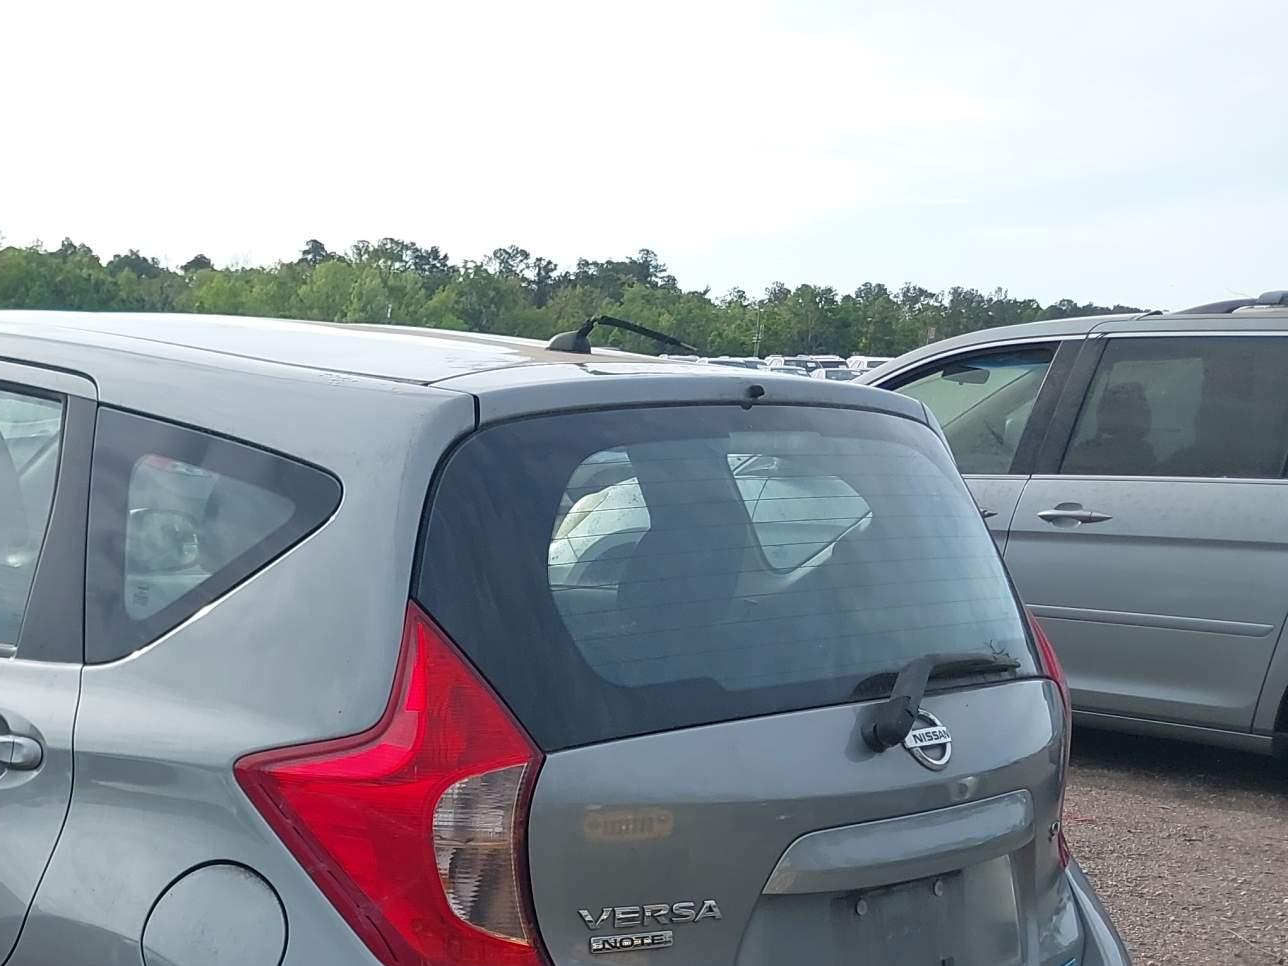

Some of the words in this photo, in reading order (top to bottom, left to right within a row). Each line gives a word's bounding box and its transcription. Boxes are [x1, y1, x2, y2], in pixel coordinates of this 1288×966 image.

[912, 729, 951, 744] NISSAN
[577, 899, 722, 930] VERSA
[601, 934, 667, 951] NOTE
